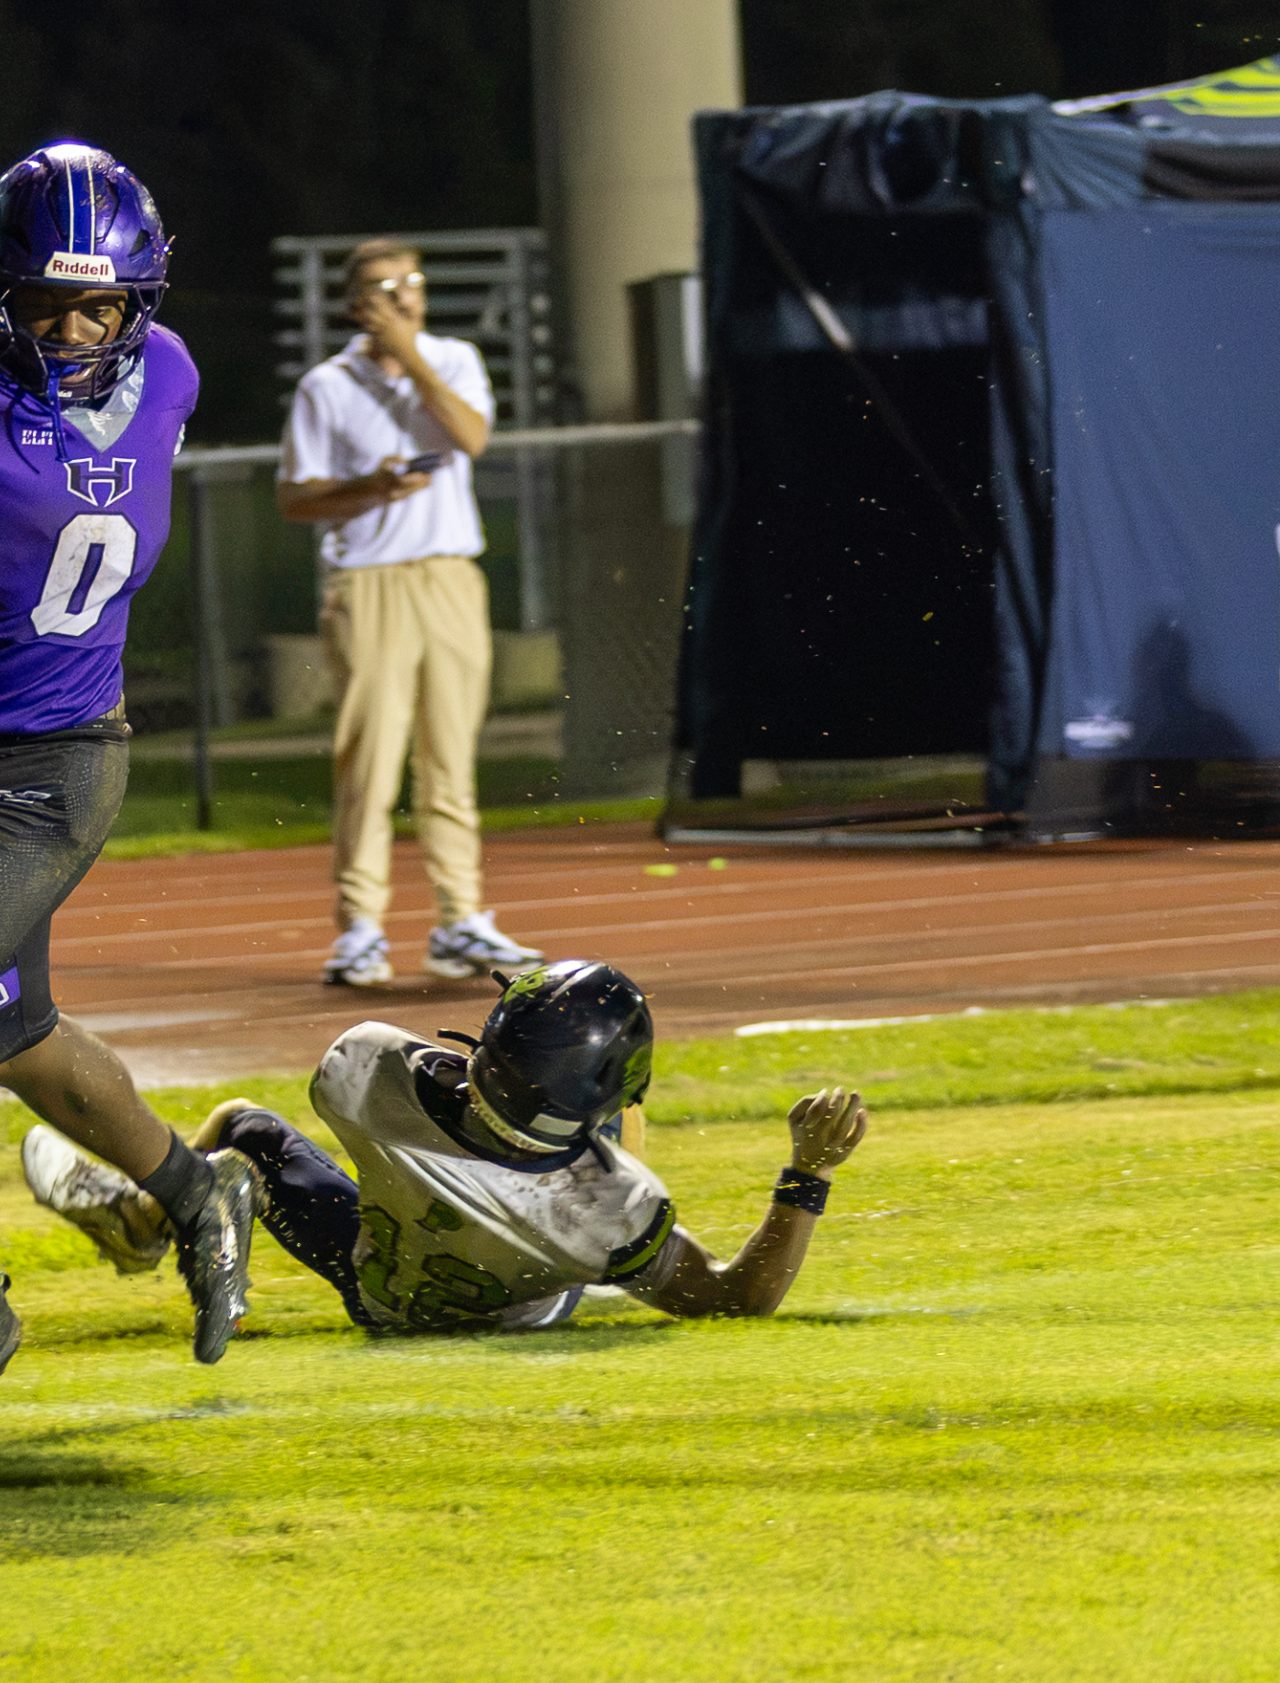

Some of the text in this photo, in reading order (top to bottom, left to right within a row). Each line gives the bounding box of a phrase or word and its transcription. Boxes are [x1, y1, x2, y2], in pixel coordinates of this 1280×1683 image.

[52, 259, 110, 277] Riddell
[64, 457, 137, 508] H
[30, 513, 137, 637] 0
